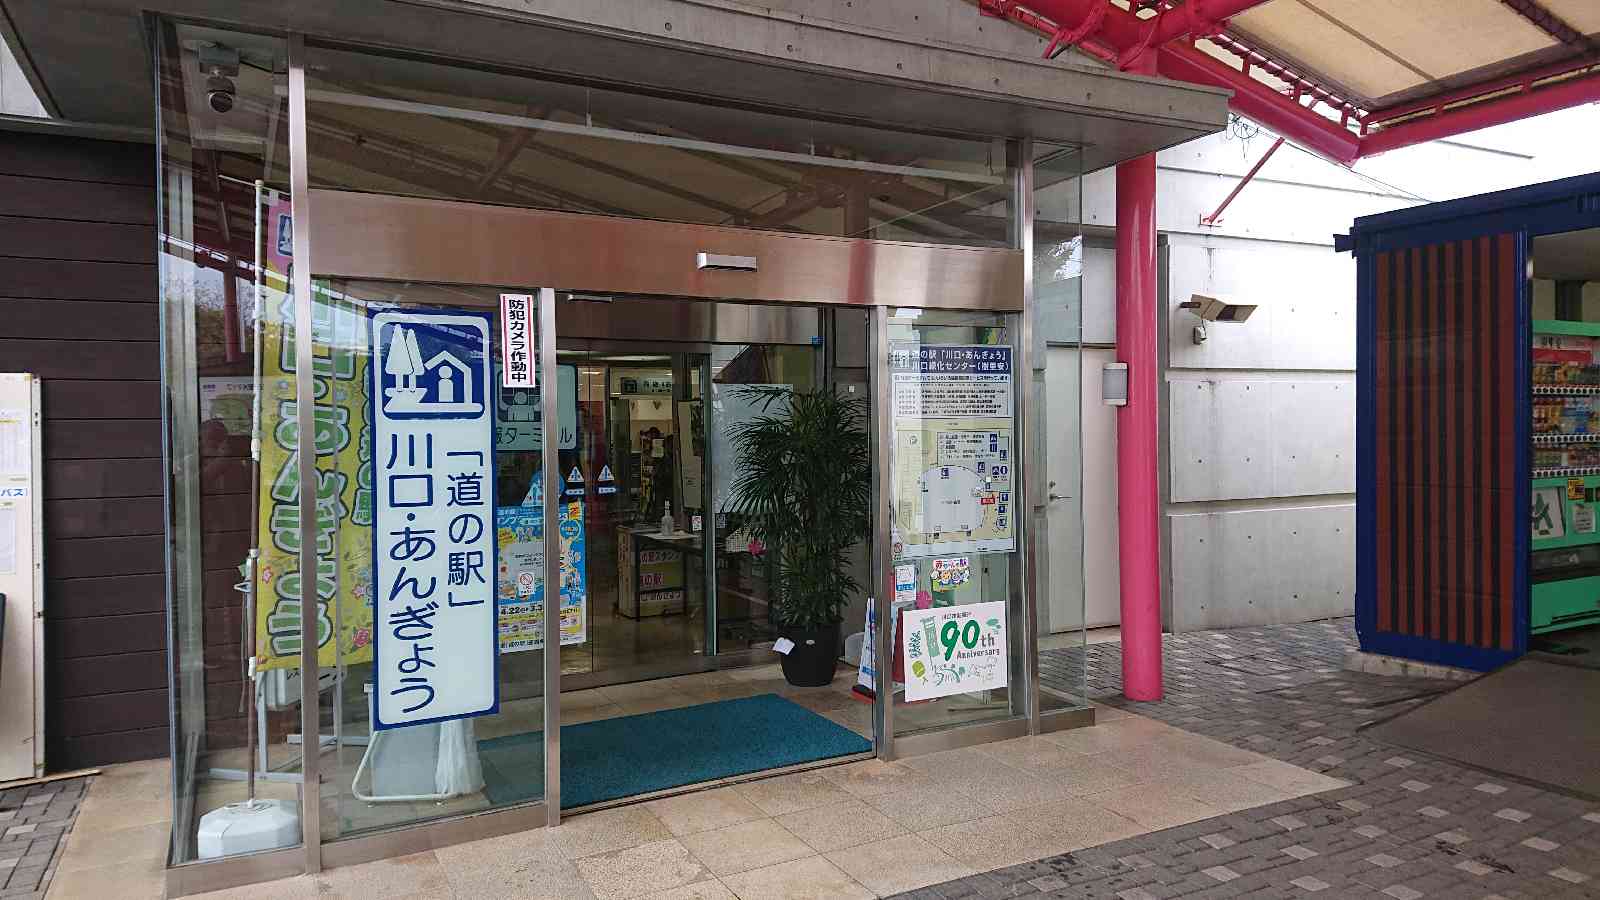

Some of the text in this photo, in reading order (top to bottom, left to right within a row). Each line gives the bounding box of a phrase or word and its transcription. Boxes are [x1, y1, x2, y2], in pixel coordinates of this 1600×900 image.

[508, 299, 526, 383] 防犯カメラ作動中
[496, 426, 573, 444] ターミル
[386, 432, 439, 714] 川口・あんぎょう
[446, 450, 486, 608] 「道の駅」
